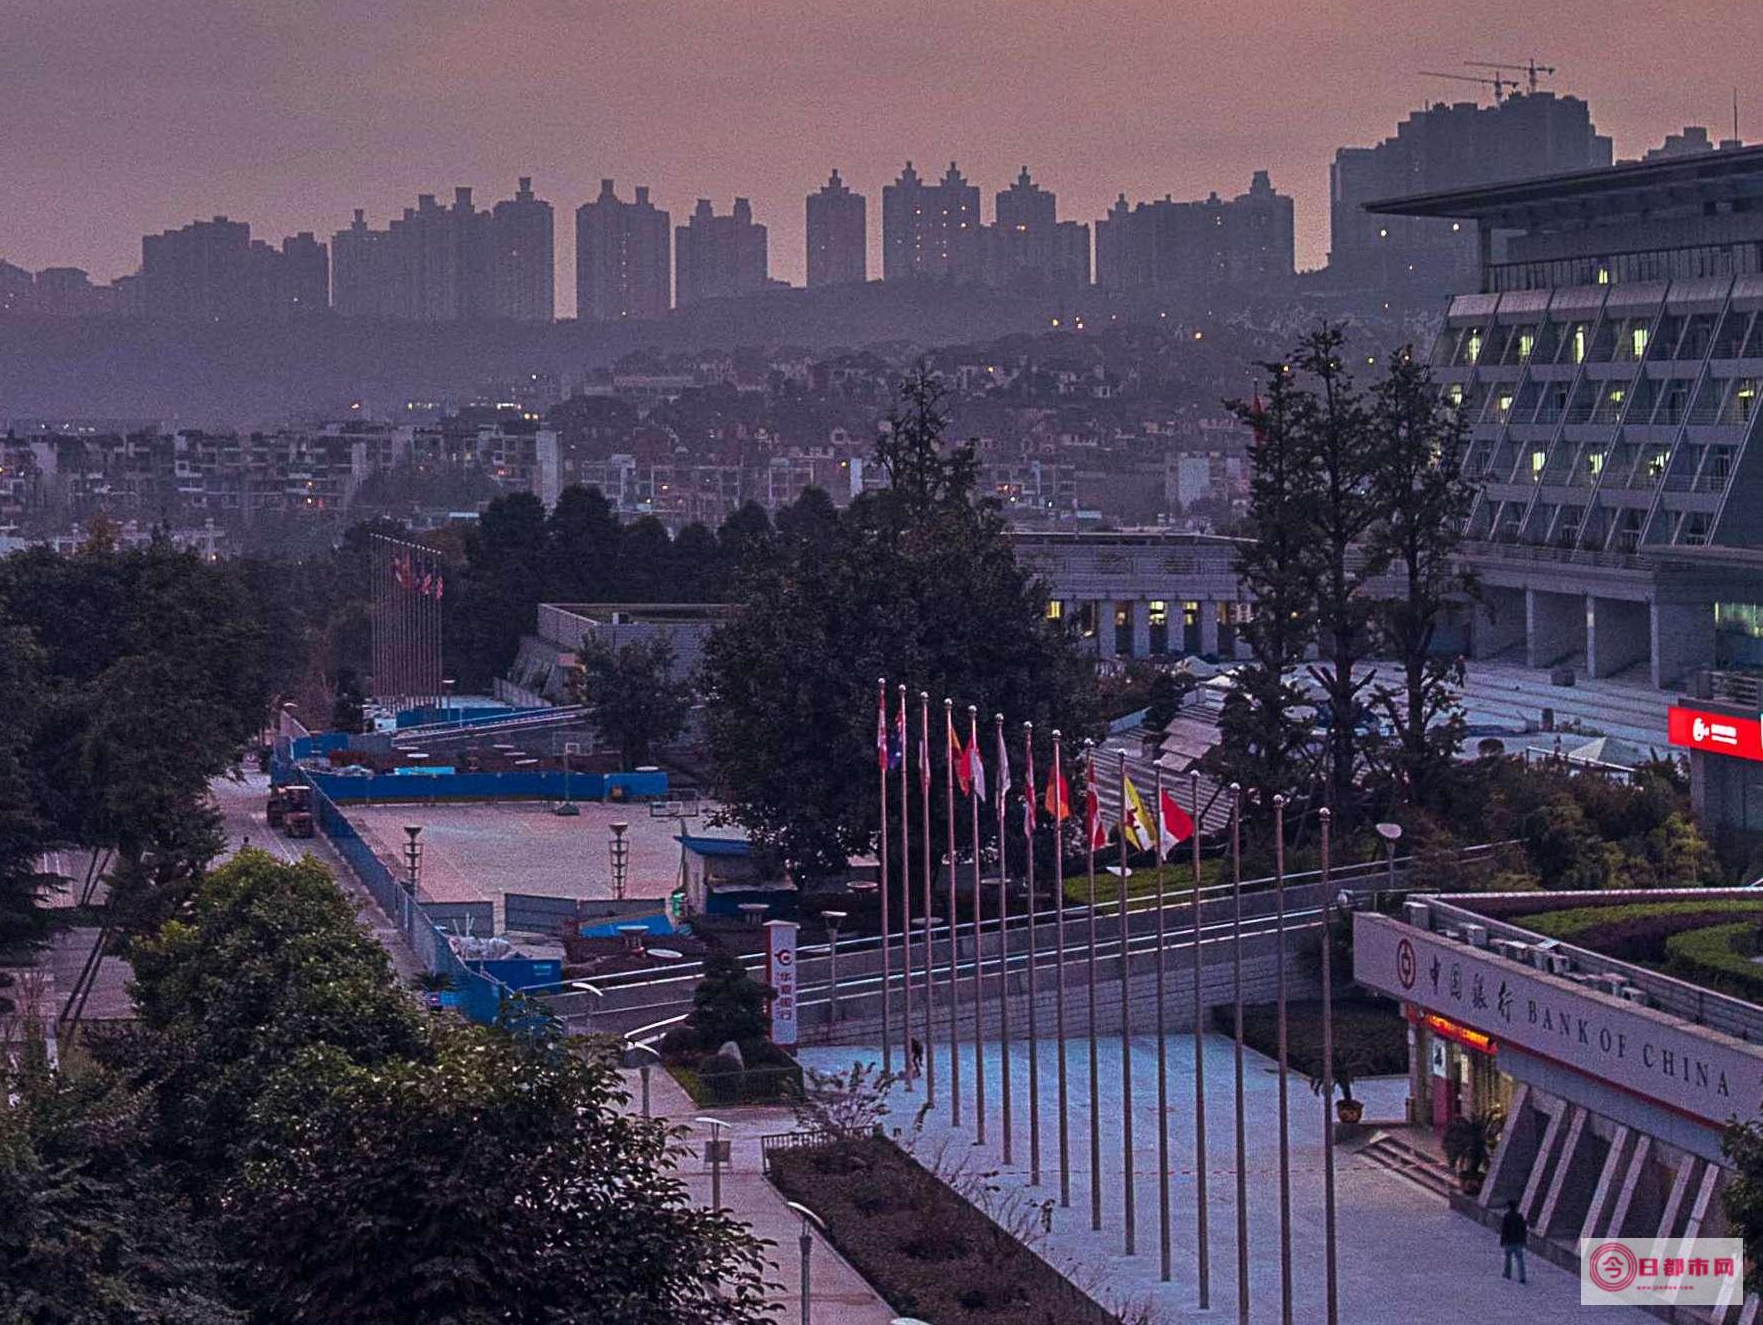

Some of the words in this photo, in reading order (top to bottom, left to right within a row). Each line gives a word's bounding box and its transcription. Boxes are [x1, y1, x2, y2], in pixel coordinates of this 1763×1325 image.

[1430, 954, 1513, 1022] 中国银行
[1528, 1000, 1588, 1044] BANK
[1599, 1028, 1627, 1058] OF
[1643, 1043, 1730, 1097] CHINA
